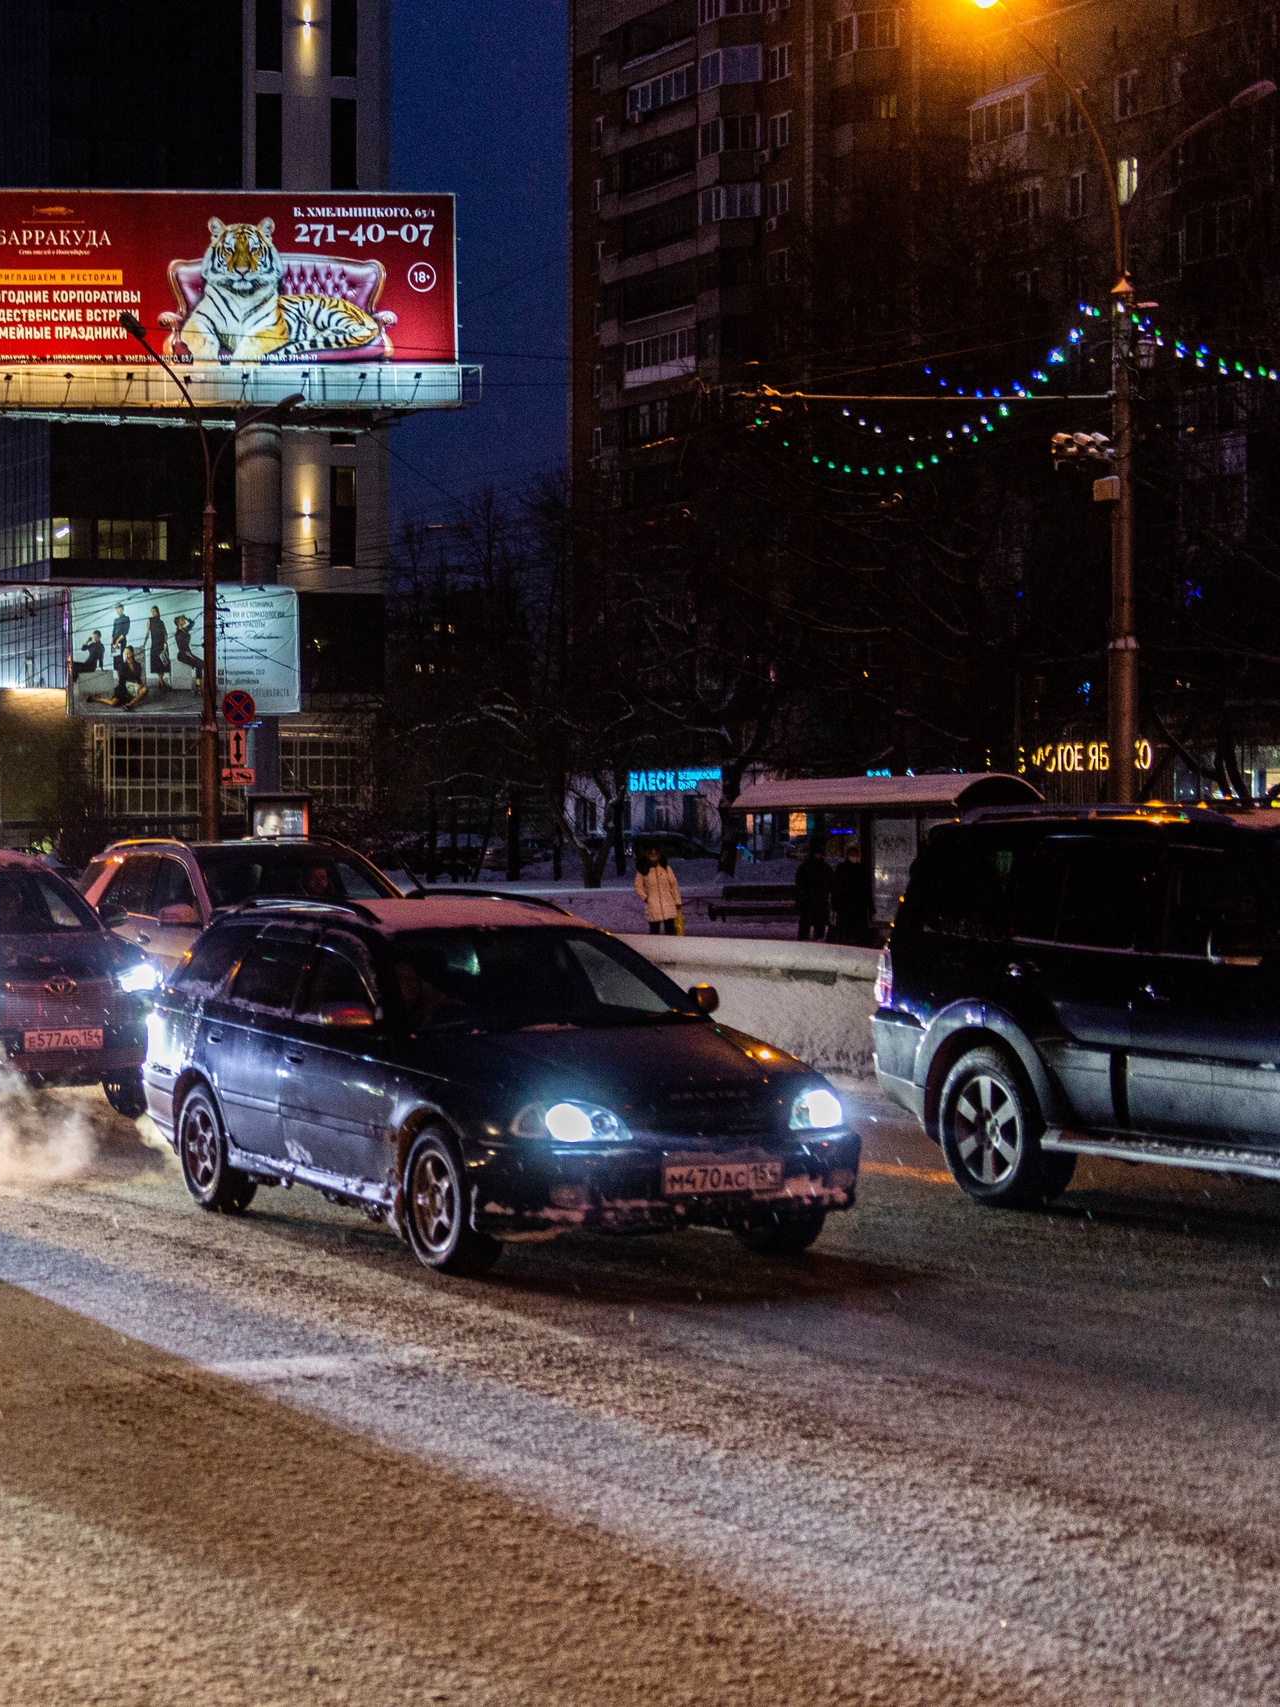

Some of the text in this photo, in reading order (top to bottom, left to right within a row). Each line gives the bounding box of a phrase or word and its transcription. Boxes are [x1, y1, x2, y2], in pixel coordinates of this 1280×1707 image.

[293, 207, 435, 219] Б. ХМЕЛЬНИЦКОГО, 65/1
[294, 223, 434, 247] 271-40-07
[61, 274, 66, 282] В
[70, 274, 118, 282] РЕСТОРАН
[413, 271, 431, 283] 18+
[52, 290, 141, 303] КОРПОРАТИВЫ
[86, 308, 140, 322] ВСТРЕИ
[55, 327, 128, 341] ПРАЗДНИКИ
[629, 770, 676, 792] БЛЕСК
